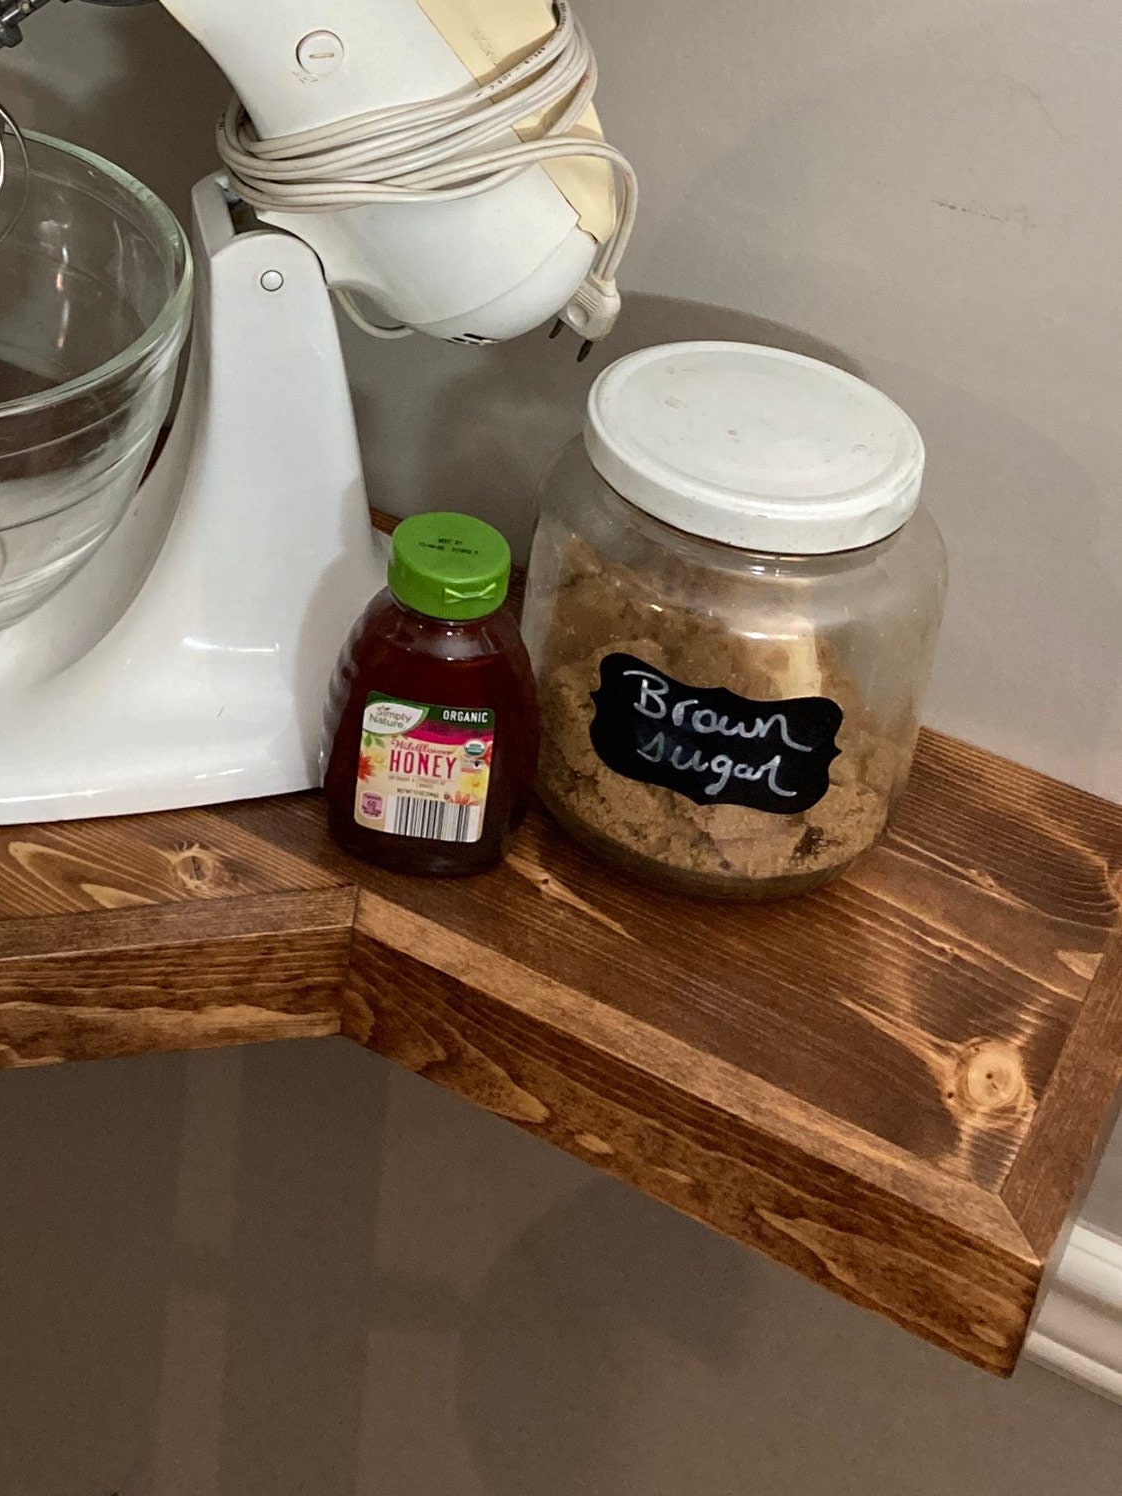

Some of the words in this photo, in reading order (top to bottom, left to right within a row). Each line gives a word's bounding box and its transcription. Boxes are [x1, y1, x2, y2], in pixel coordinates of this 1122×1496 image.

[377, 705, 412, 723] Simply
[442, 709, 488, 723] ORGANIC
[623, 670, 813, 752] Brown
[389, 749, 457, 779] HONEY
